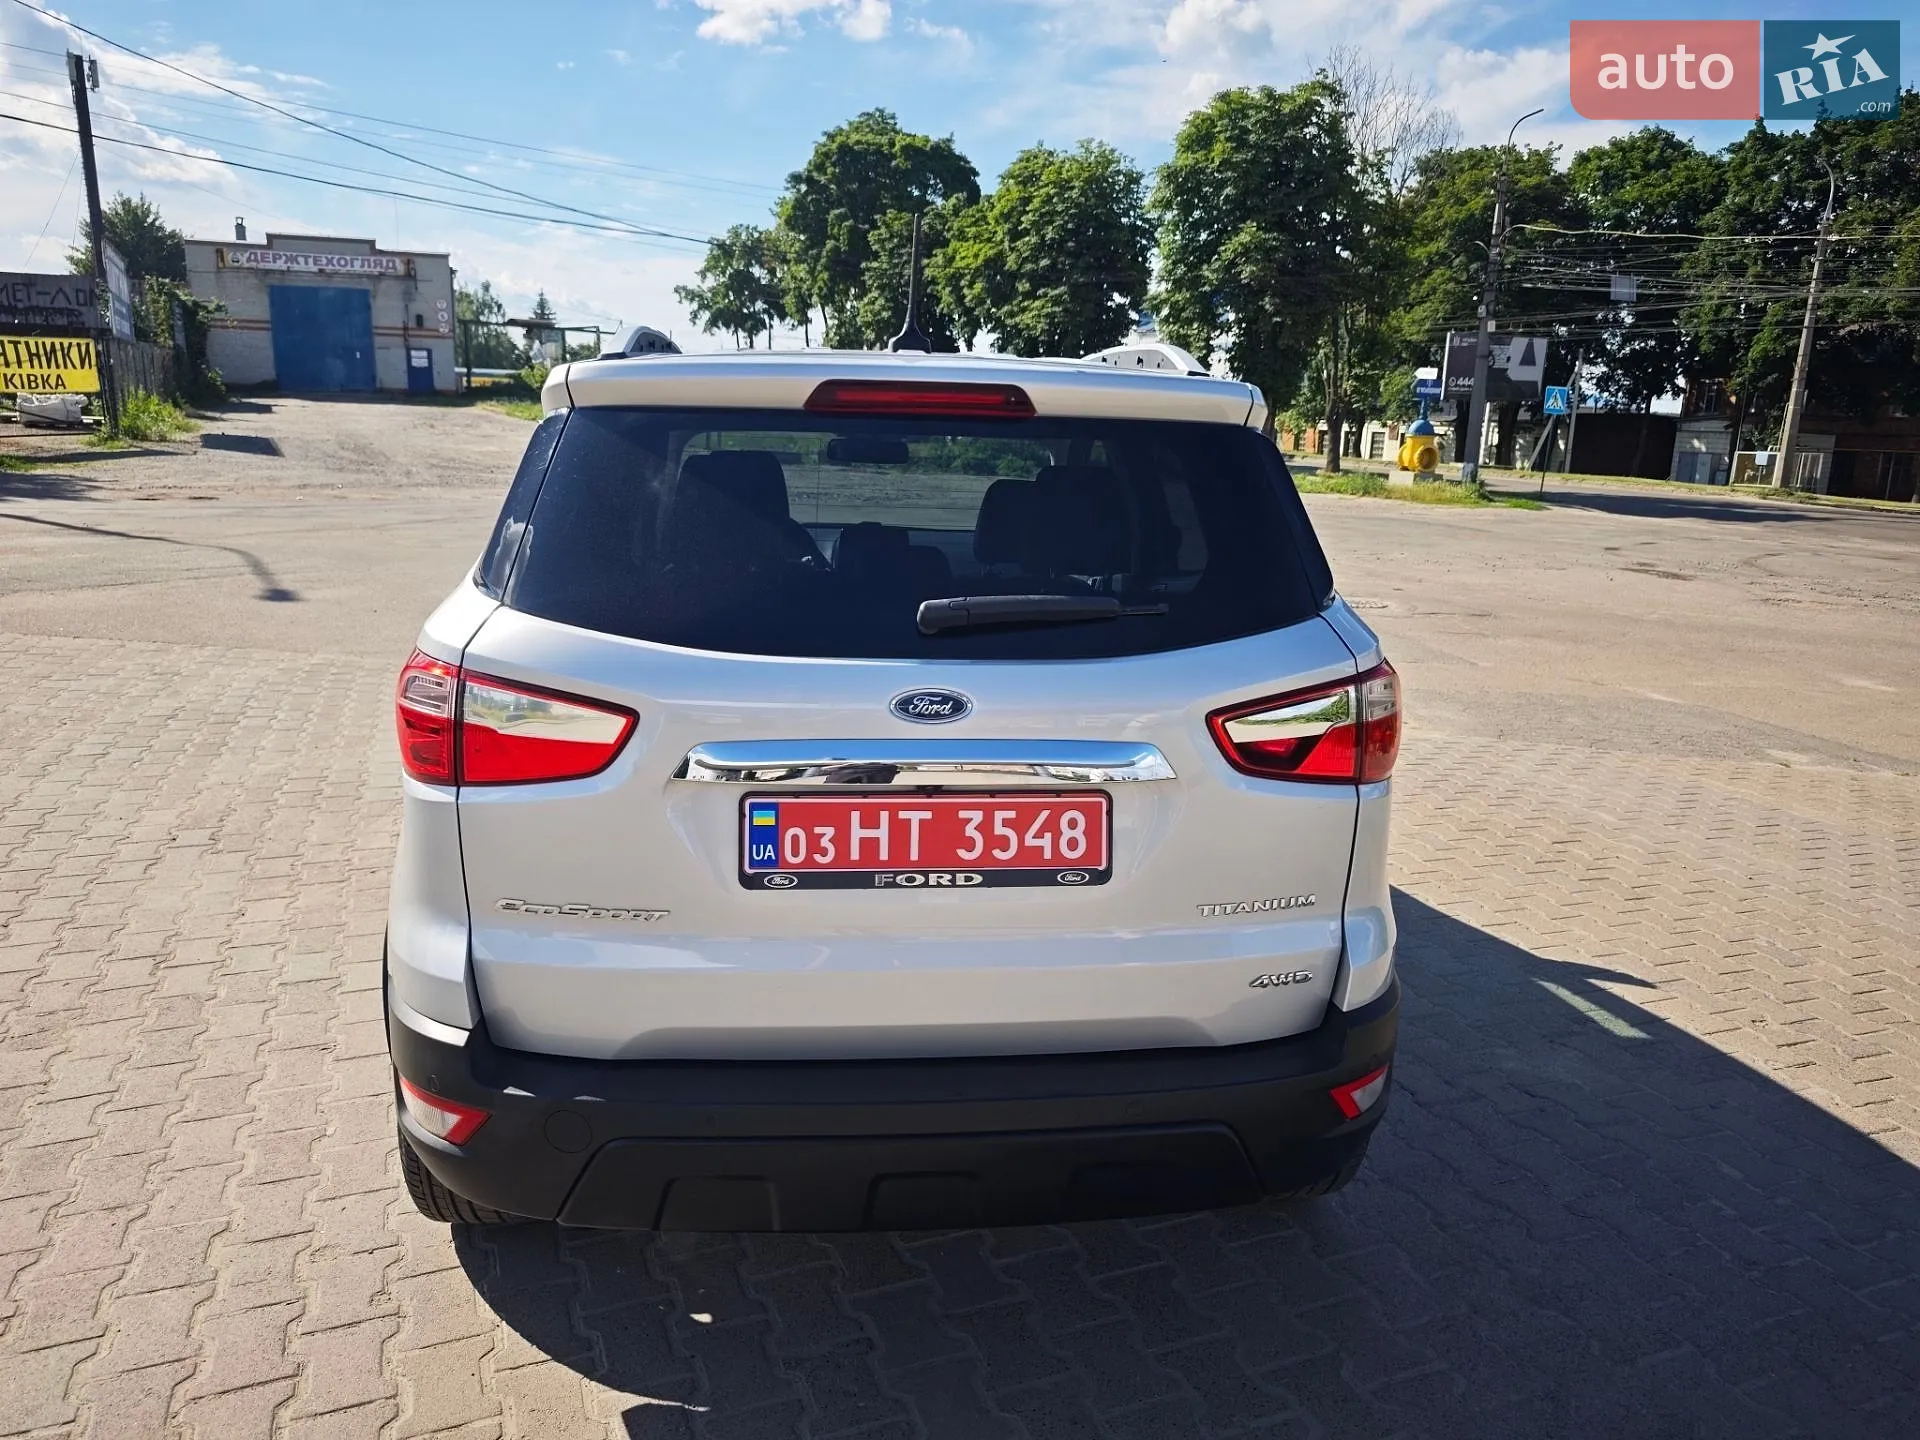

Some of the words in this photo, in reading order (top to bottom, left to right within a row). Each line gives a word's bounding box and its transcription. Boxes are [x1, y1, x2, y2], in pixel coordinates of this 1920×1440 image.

[246, 250, 397, 272] ДЕРЖТЕХОГЛЯД
[909, 695, 954, 715] Ford
[784, 826, 836, 865] 03
[850, 810, 933, 862] HT
[956, 809, 1087, 862] 3548
[752, 844, 776, 861] UA
[875, 873, 983, 886] FORD
[1197, 894, 1317, 917] TITANIUM
[1249, 970, 1313, 988] 4WD
